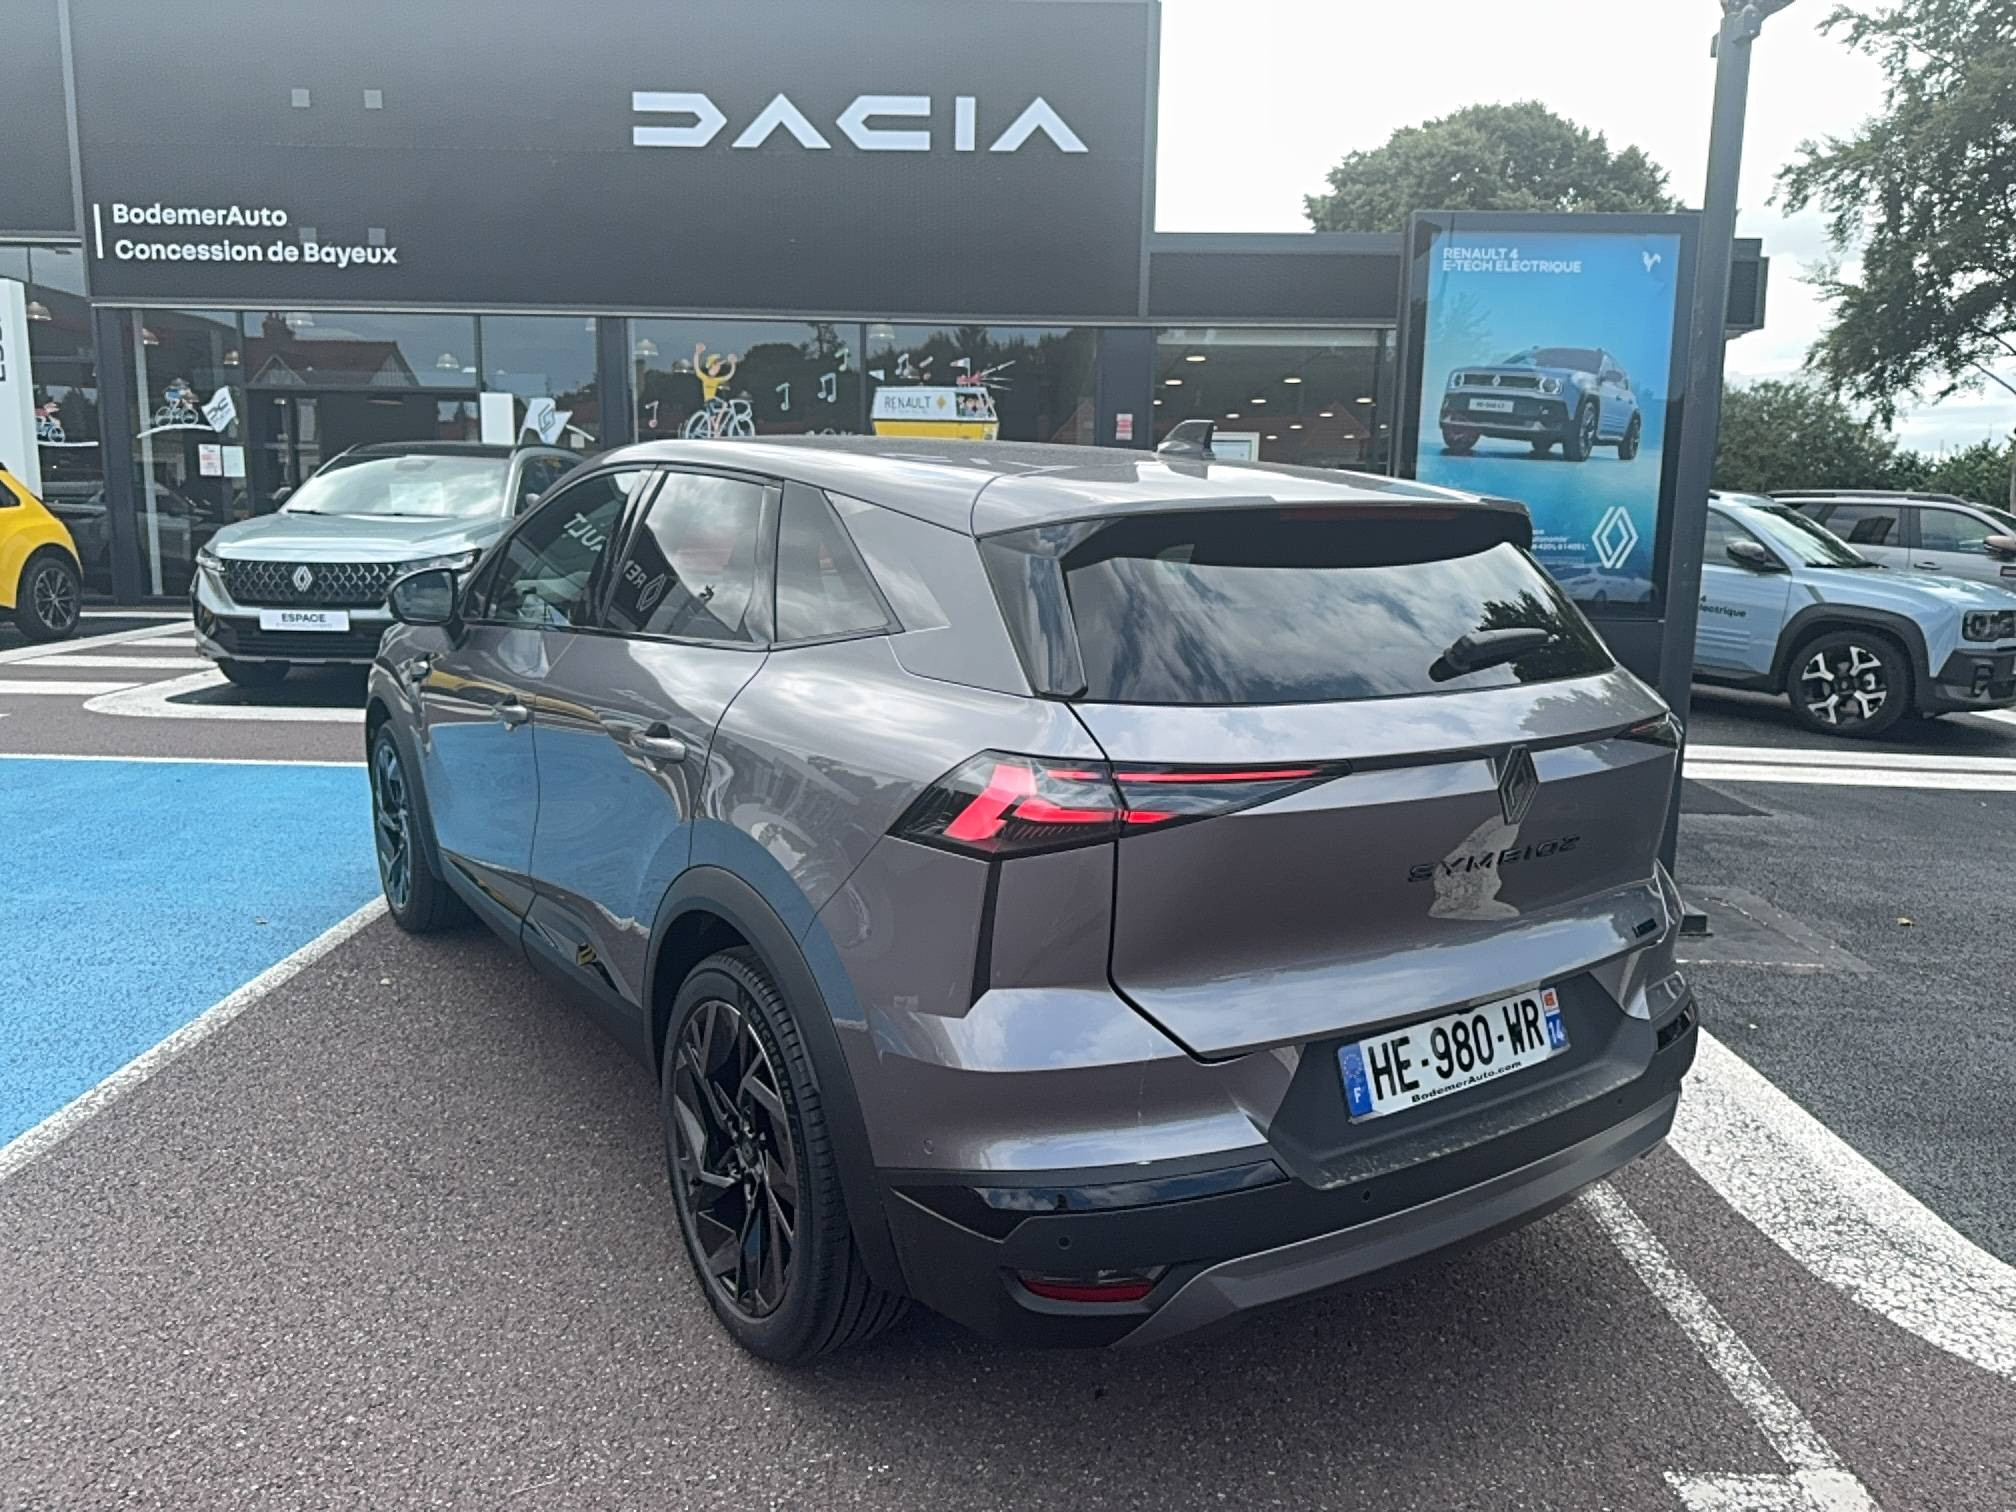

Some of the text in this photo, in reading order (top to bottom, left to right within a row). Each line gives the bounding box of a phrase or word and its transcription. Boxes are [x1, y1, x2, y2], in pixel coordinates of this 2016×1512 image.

[632, 92, 1089, 152] DACIA
[112, 204, 288, 226] BodemerAuto
[115, 240, 398, 268] Concession de Bayeux
[1443, 248, 1519, 260] RENAULT 4
[1442, 259, 1491, 272] E-TECH
[884, 395, 931, 409] RENAULT
[281, 613, 327, 623] ESPACE
[1699, 604, 1746, 618] lectrique
[1408, 835, 1580, 882] SYMBIOZ
[1367, 998, 1545, 1101] HE-980-WR
[1411, 1060, 1523, 1104] BodemerAuto.com
[1353, 1086, 1362, 1104] F
